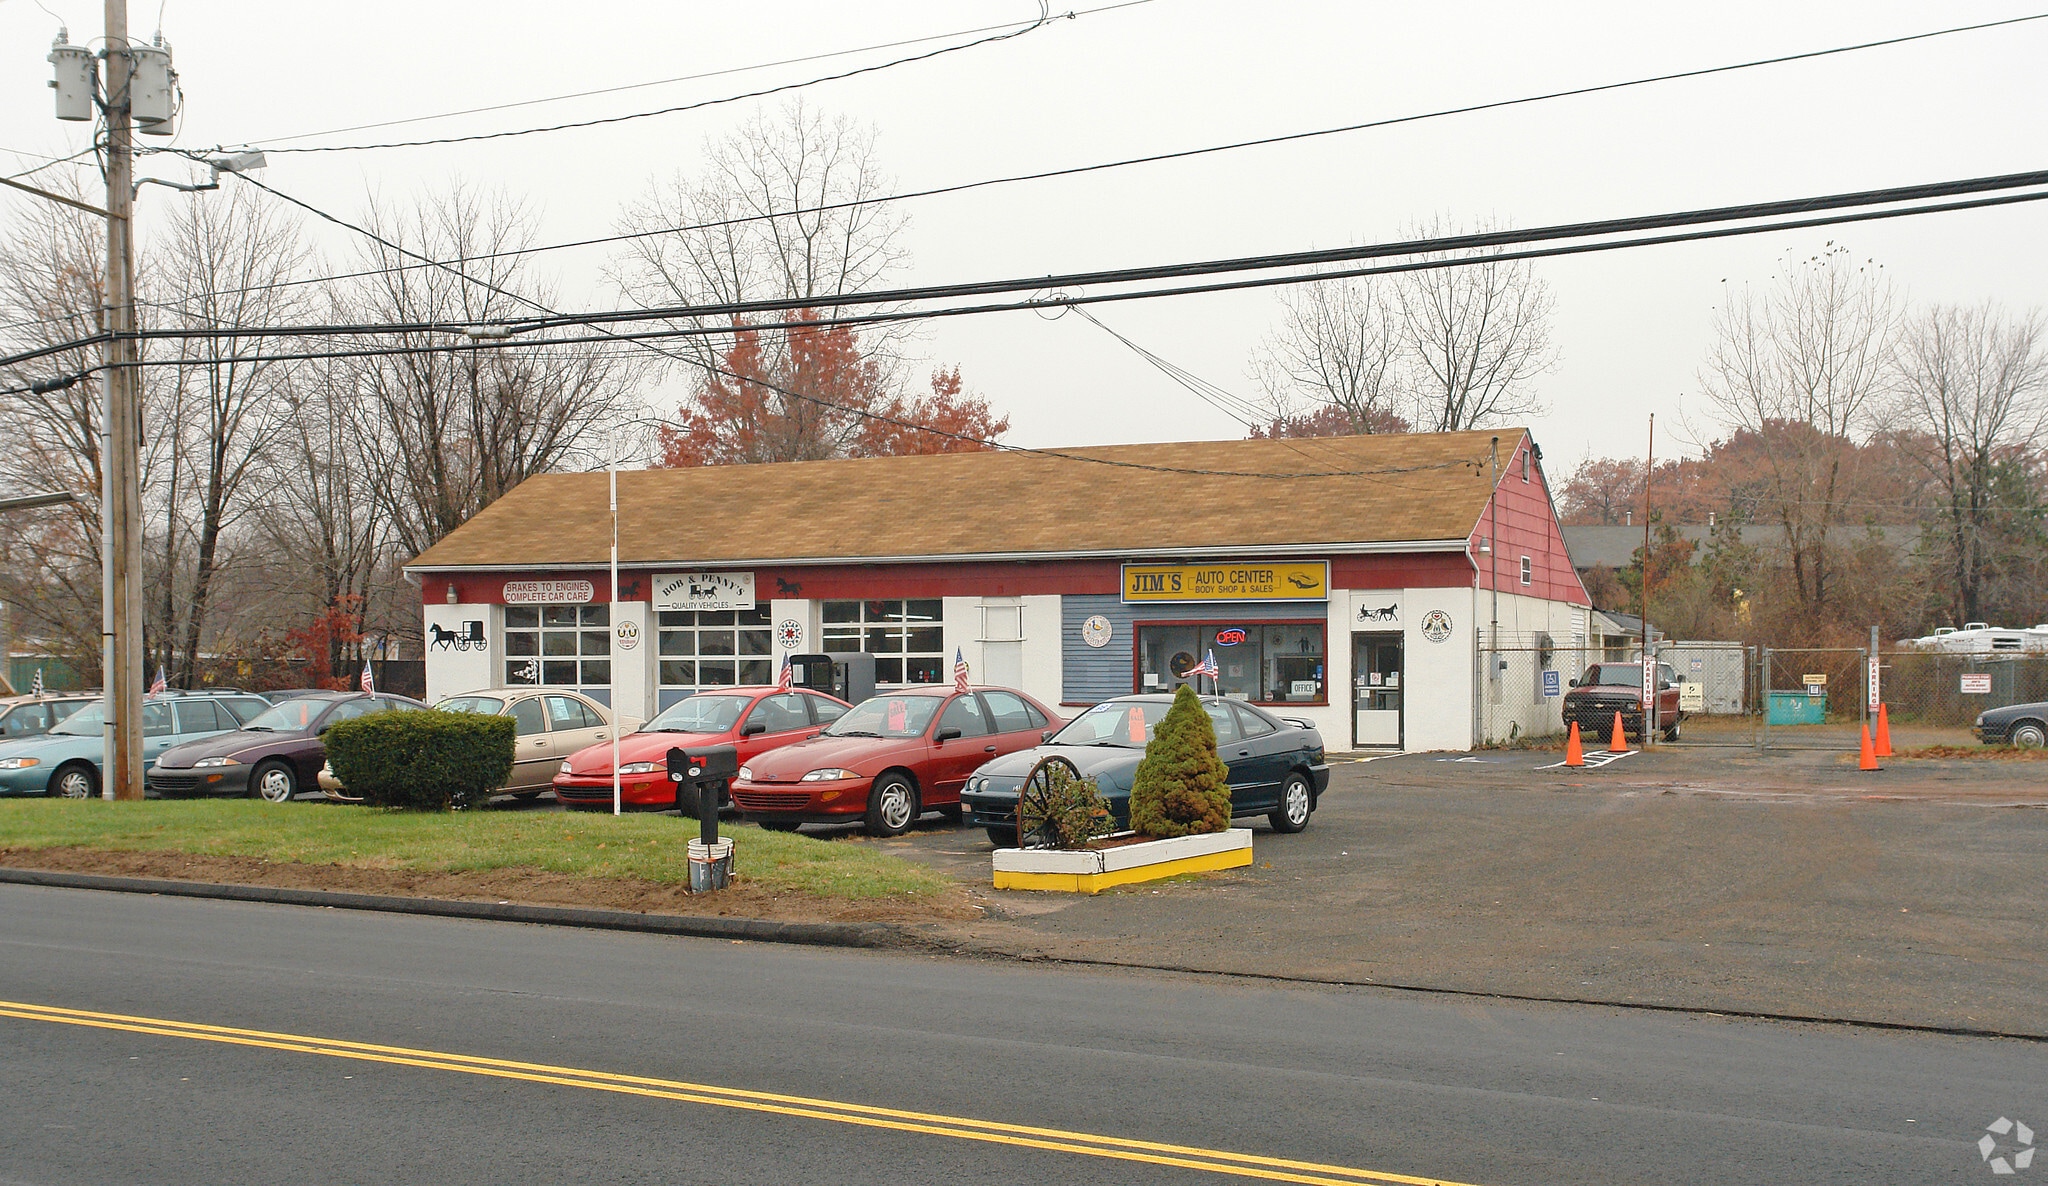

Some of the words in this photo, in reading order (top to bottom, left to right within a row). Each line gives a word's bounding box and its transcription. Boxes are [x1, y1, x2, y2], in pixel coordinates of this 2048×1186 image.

[1195, 571, 1225, 584] AUTO
[1229, 570, 1274, 584] CENTER
[506, 582, 538, 592] BRAKES
[541, 582, 552, 592] TO
[555, 582, 590, 591] ENGINES
[662, 579, 684, 597] BOB
[688, 575, 696, 584] &
[701, 574, 745, 597] PENNY'S
[1218, 585, 1238, 593] SHOP
[1241, 585, 1247, 593] &
[1250, 585, 1274, 593] SALES
[505, 592, 546, 602] COMPLETE
[548, 592, 564, 601] CAR
[567, 592, 589, 601] CARE
[671, 602, 698, 610] QUALITY
[699, 601, 729, 609] VEHICLES
[1216, 631, 1246, 643] OPEN
[1294, 684, 1313, 692] OFFICE
